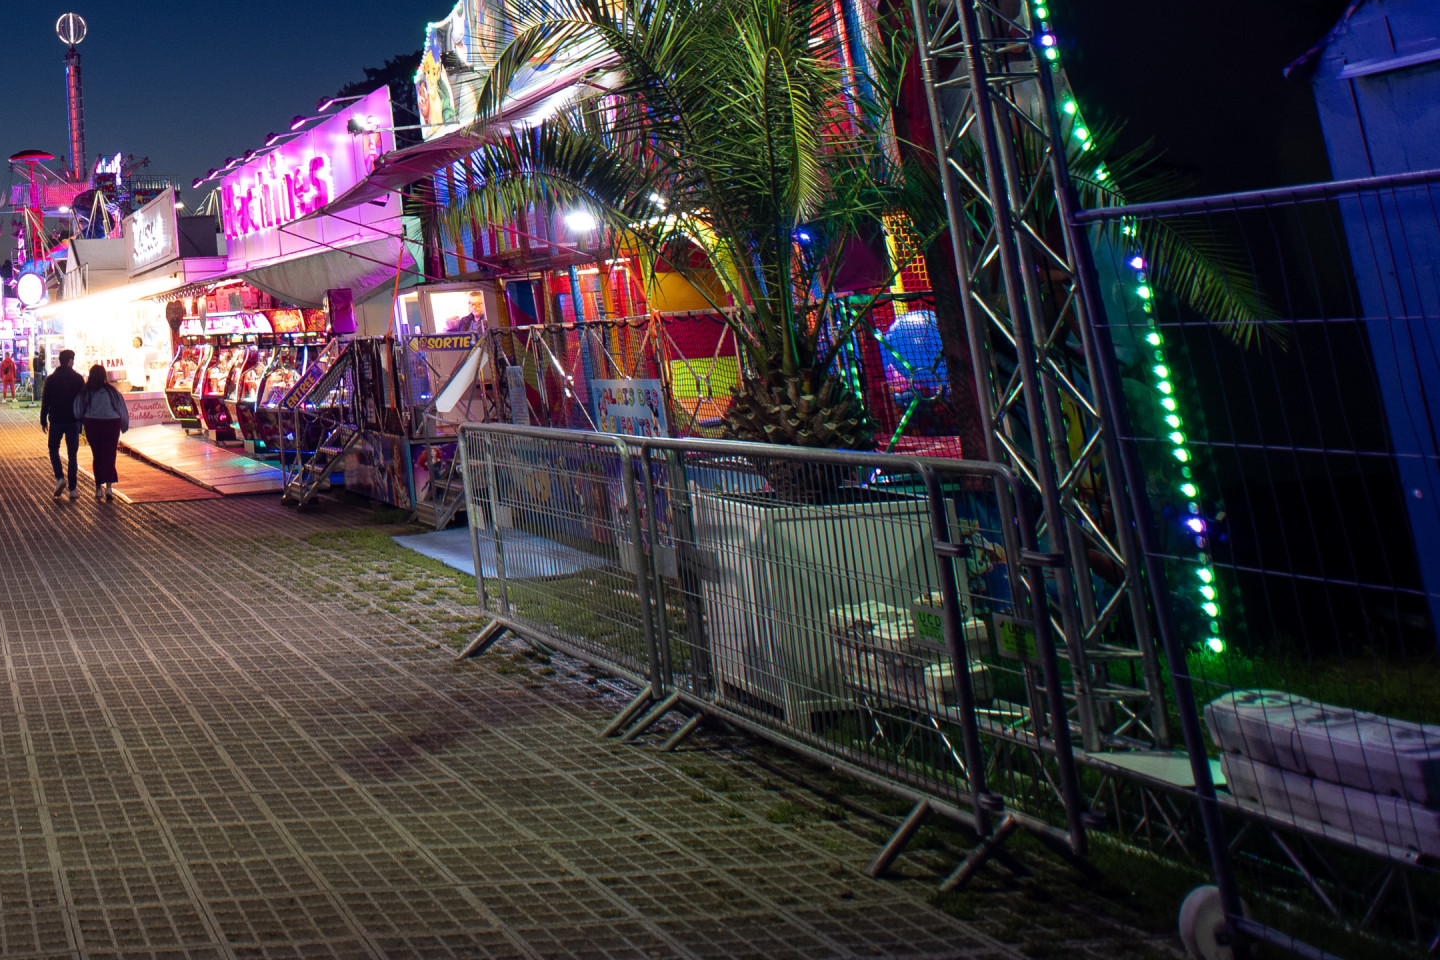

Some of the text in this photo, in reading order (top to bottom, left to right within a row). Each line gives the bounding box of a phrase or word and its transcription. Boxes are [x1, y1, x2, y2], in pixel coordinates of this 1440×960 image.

[427, 336, 471, 350] SORTIE
[106, 358, 124, 368] PAPA
[286, 373, 316, 409] ENTREE
[595, 387, 659, 408] PALAIS DES
